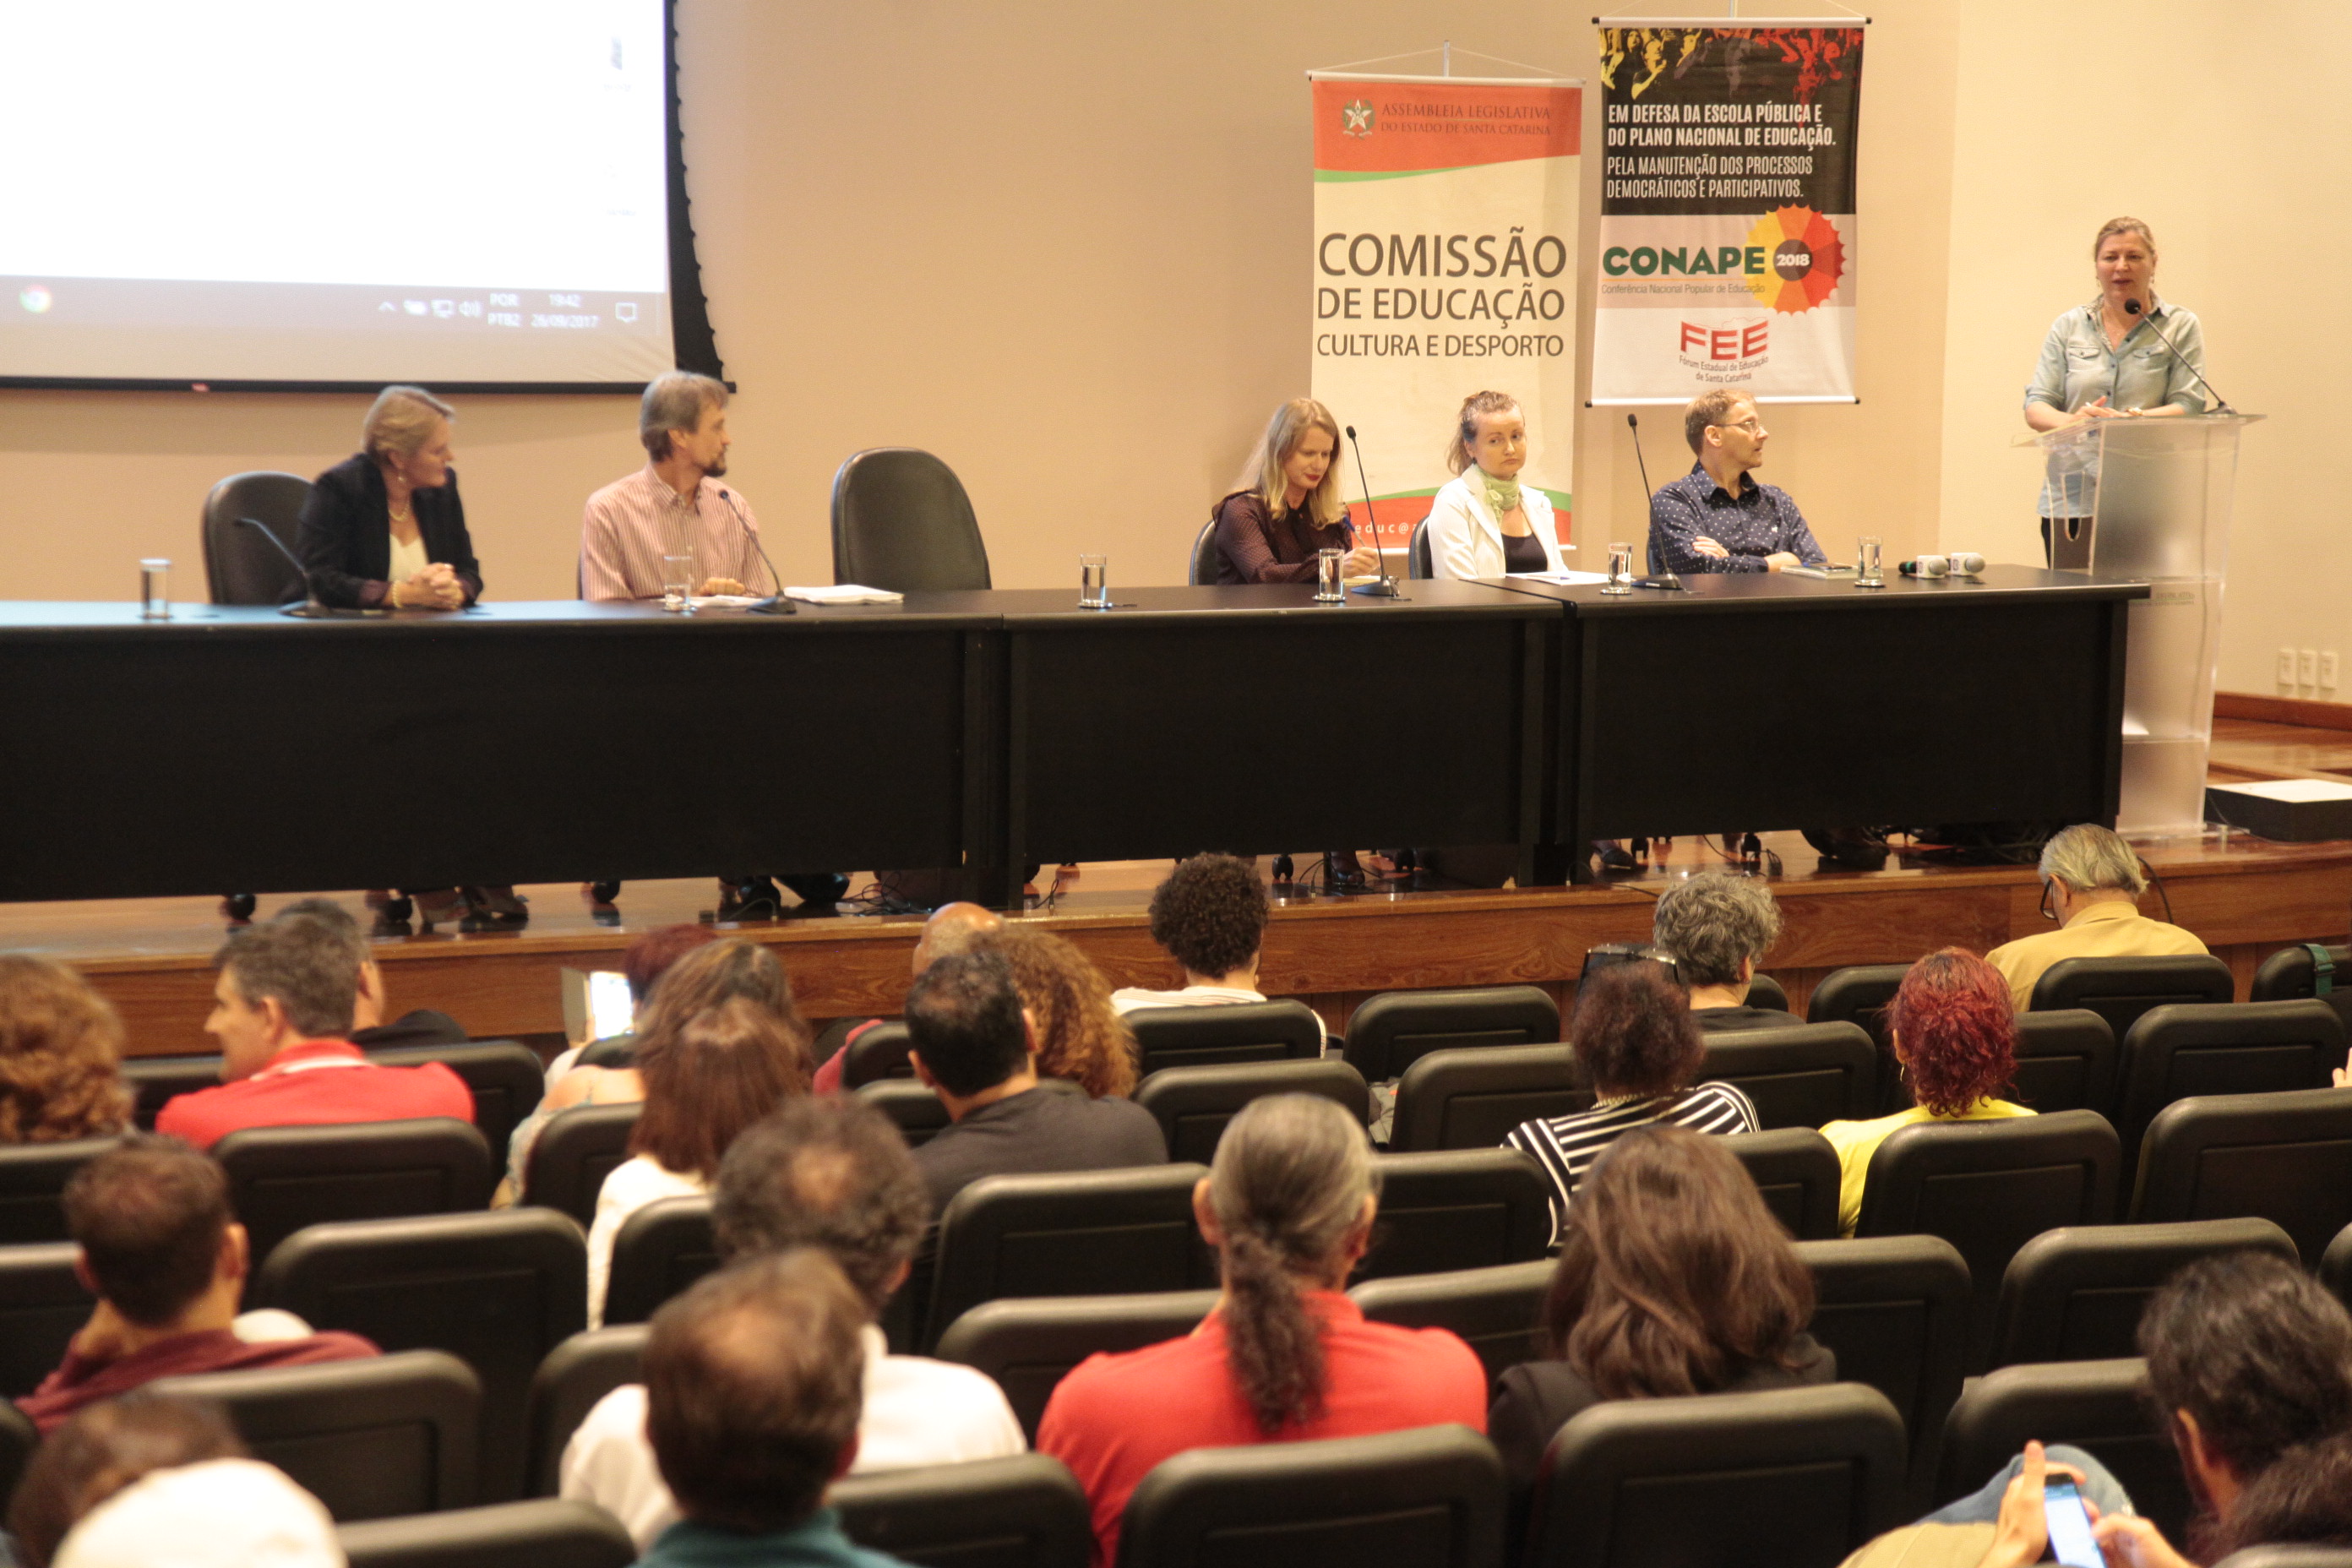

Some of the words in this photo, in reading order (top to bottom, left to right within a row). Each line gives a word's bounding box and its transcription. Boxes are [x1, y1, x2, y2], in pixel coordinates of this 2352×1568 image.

[1382, 102, 1463, 117] ASSEMBLEIA
[1468, 105, 1550, 119] LEGISLATIVA
[1609, 104, 1629, 123] EM
[1632, 104, 1680, 123] DEFESA
[1684, 104, 1701, 123] DA
[1704, 104, 1752, 123] ESCOLA
[1756, 101, 1811, 122] PÚBLICA
[1815, 104, 1822, 122] E
[1381, 122, 1397, 132] DO
[1400, 122, 1442, 133] ESTADO
[1446, 123, 1459, 133] DE
[1463, 123, 1495, 134] SANTA
[1499, 125, 1550, 135] CATARINA
[1608, 128, 1625, 146] DO
[1629, 128, 1672, 146] PLANO
[1675, 128, 1741, 146] NACIONAL
[1745, 128, 1761, 145] DE
[1764, 124, 1836, 151] EDUCAÇÃO.
[1608, 156, 1636, 175] PELA
[1638, 154, 1717, 180] MANUTENÇÃO
[1720, 156, 1743, 174] DOS
[1745, 155, 1812, 174] PROCESSOS
[1607, 177, 1696, 198] DEMOCRÁTICOS
[1699, 180, 1705, 198] E
[1708, 179, 1804, 198] PARTICIPATIVOS.
[1319, 226, 1567, 278] COMISSÃO
[1603, 247, 1765, 275] CONAPE
[1777, 253, 1810, 266] 2018
[1602, 284, 1647, 294] Conferência
[1649, 284, 1683, 294] Nacional
[1685, 284, 1714, 295] Popular
[1716, 284, 1726, 293] de
[1729, 283, 1765, 295] Educação
[1317, 287, 1361, 319] DE
[1374, 283, 1565, 329] EDUCAÇÃO
[1317, 335, 1420, 357] CULTURA
[1427, 335, 1439, 357] E
[1446, 335, 1564, 357] DESPORTO
[1680, 320, 1768, 360] FEE
[1679, 355, 1699, 368] Fórum
[1701, 361, 1728, 372] Estadual
[1729, 362, 1737, 371] de
[1739, 356, 1768, 370] Educação
[1696, 372, 1704, 380] de
[1705, 373, 1723, 382] Santa
[1724, 372, 1751, 383] Catarina
